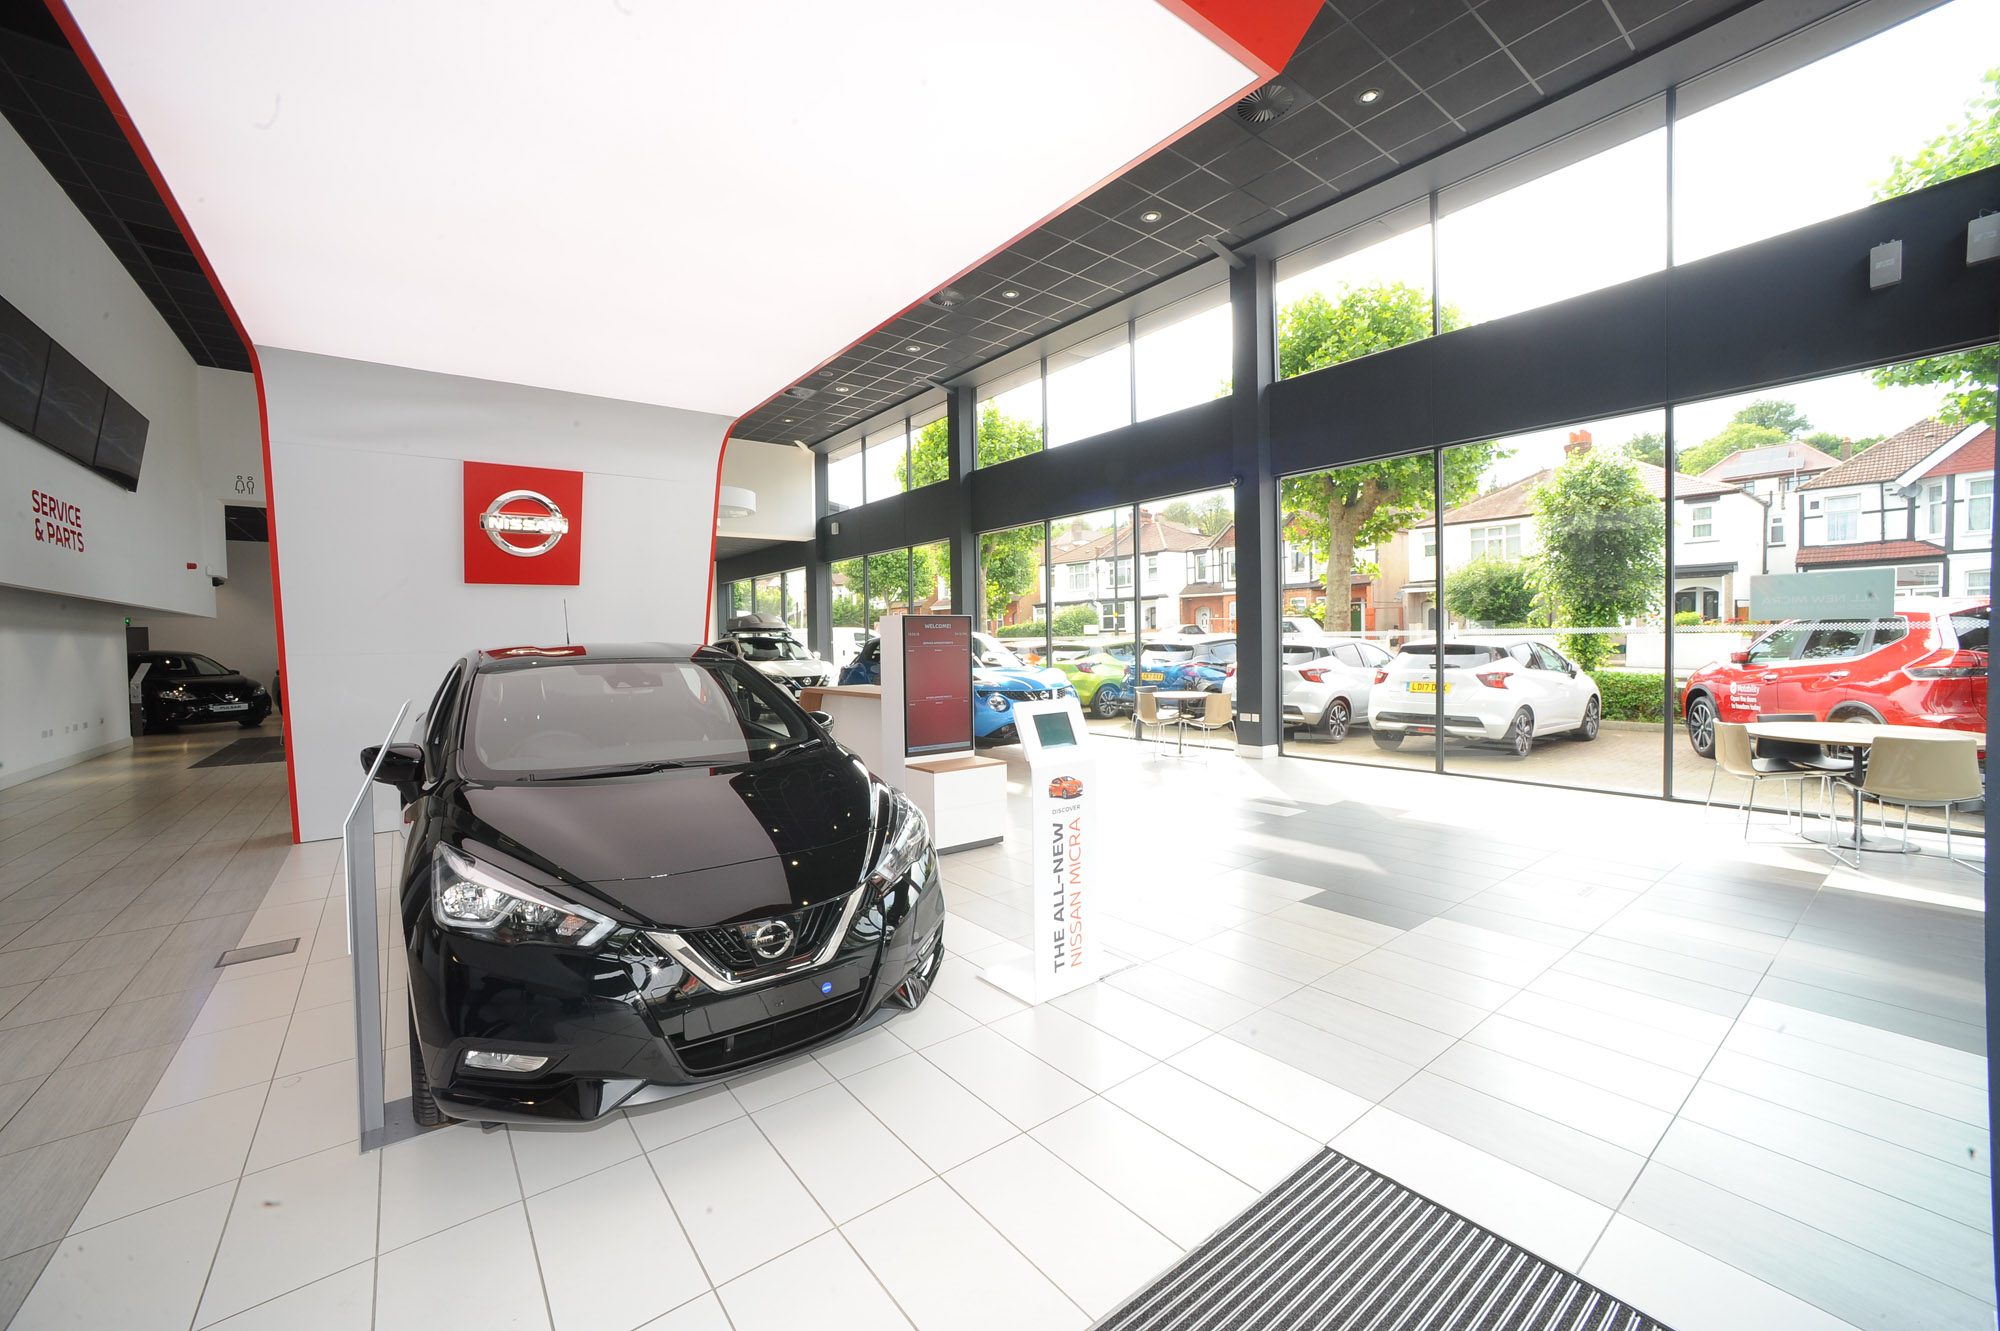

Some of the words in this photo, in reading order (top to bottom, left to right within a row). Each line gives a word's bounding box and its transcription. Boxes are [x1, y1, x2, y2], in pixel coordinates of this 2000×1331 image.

[32, 489, 82, 528] SERVICE
[488, 516, 562, 533] NISSAN
[35, 517, 44, 542] &
[46, 521, 85, 553] PARTS
[1052, 804, 1081, 815] DISCOVER
[1069, 817, 1081, 884] MICRA
[1052, 823, 1064, 921] ALL-NEW
[1069, 891, 1082, 968] NISSAN
[1054, 928, 1065, 974] THE
